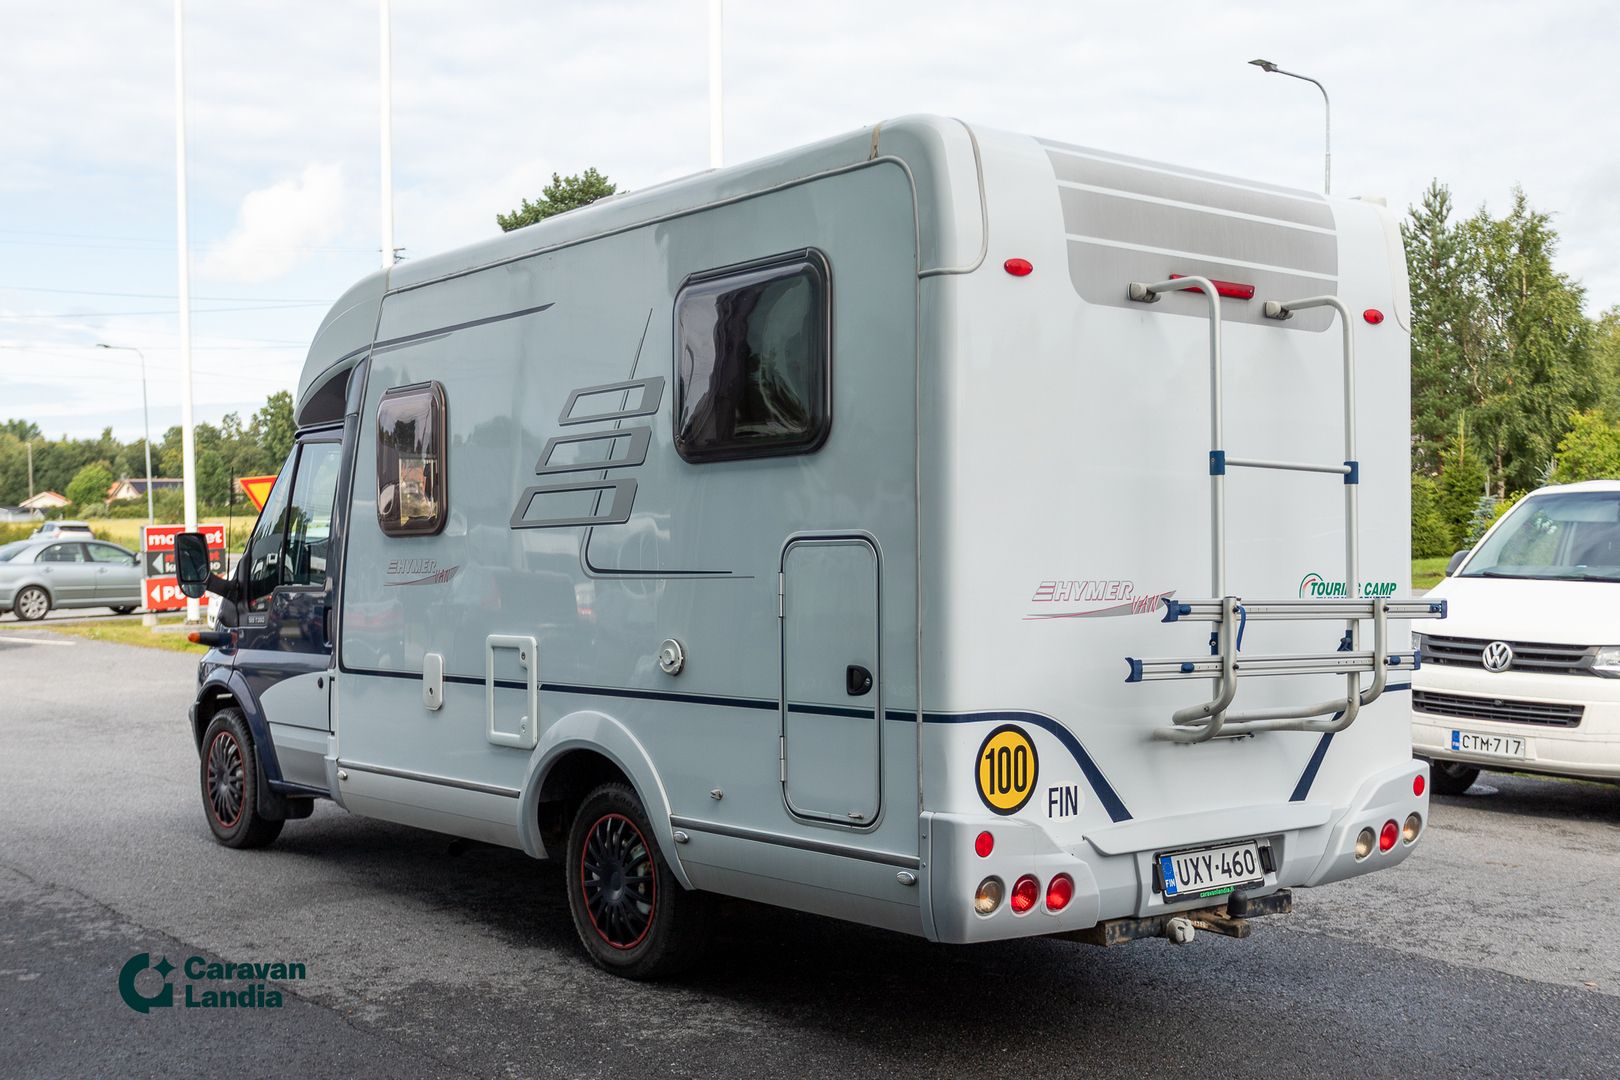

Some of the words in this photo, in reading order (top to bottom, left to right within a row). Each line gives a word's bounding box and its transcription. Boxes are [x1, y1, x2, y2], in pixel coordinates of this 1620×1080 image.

[148, 530, 223, 546] moet
[1310, 582, 1361, 596] TOURI
[1364, 582, 1397, 596] CAMP
[1131, 594, 1160, 615] VAN
[1462, 735, 1521, 755] CTM-717
[985, 744, 1029, 796] 100
[1048, 784, 1078, 819] FIN
[1176, 849, 1256, 886] UXY-460
[1165, 878, 1176, 889] FIN
